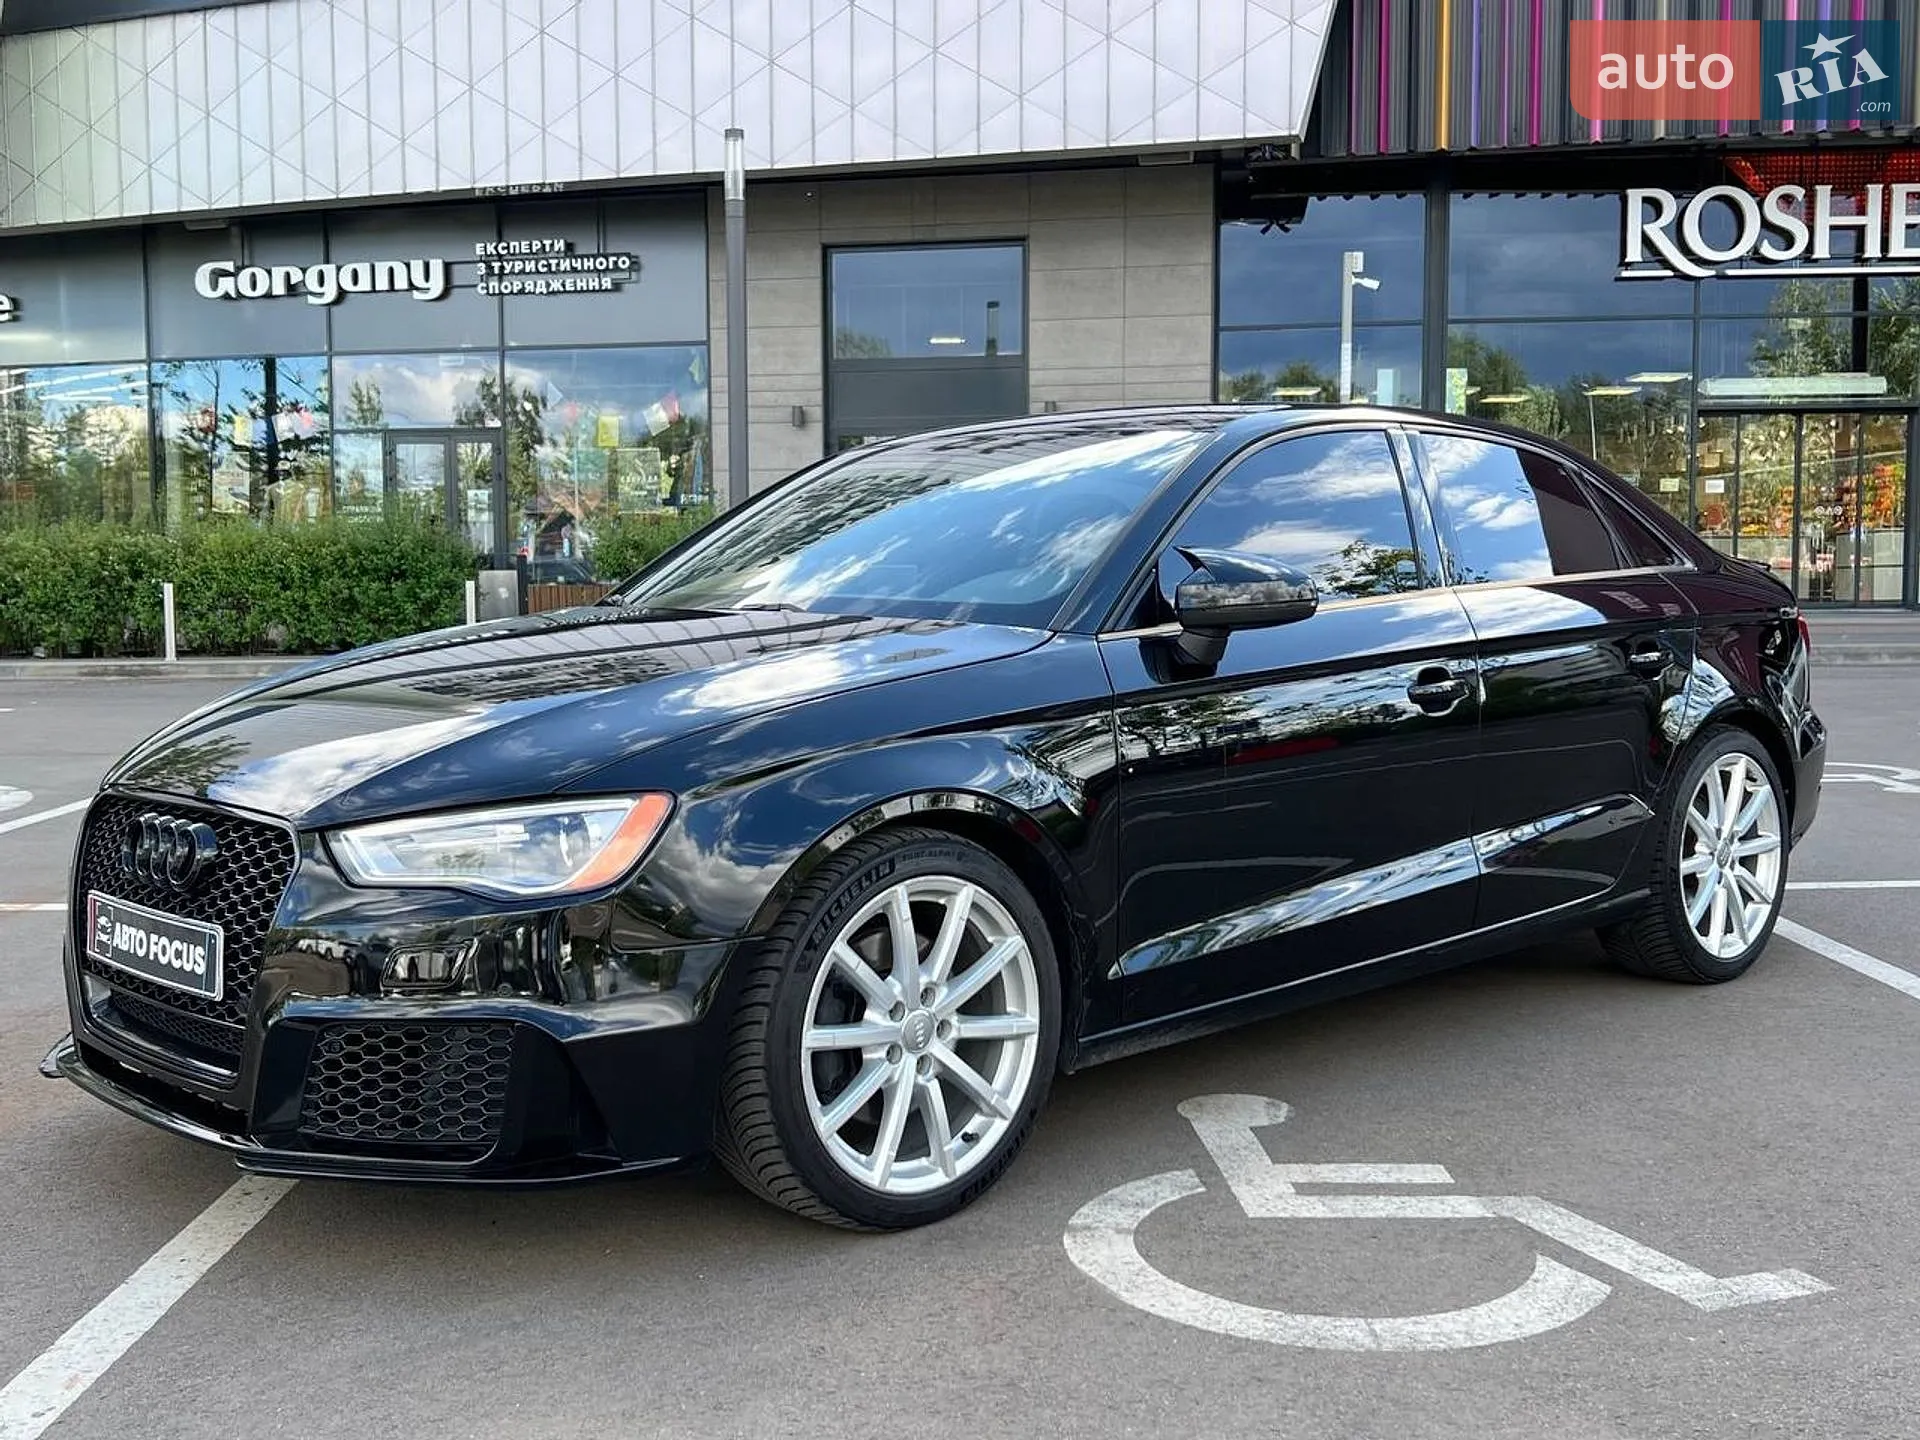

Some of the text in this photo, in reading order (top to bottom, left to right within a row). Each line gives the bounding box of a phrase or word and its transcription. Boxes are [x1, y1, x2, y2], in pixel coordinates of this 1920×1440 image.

[475, 239, 565, 255] ЕКСПЕРТИ
[1624, 184, 1920, 277] ROSHE
[194, 258, 444, 305] Gorgany
[477, 277, 612, 295] СПОРЯДЖЕННЯ
[492, 256, 630, 275] ТУРИСТИЧНОГО
[810, 858, 895, 944] MICHELIN
[149, 933, 205, 975] FOCUS
